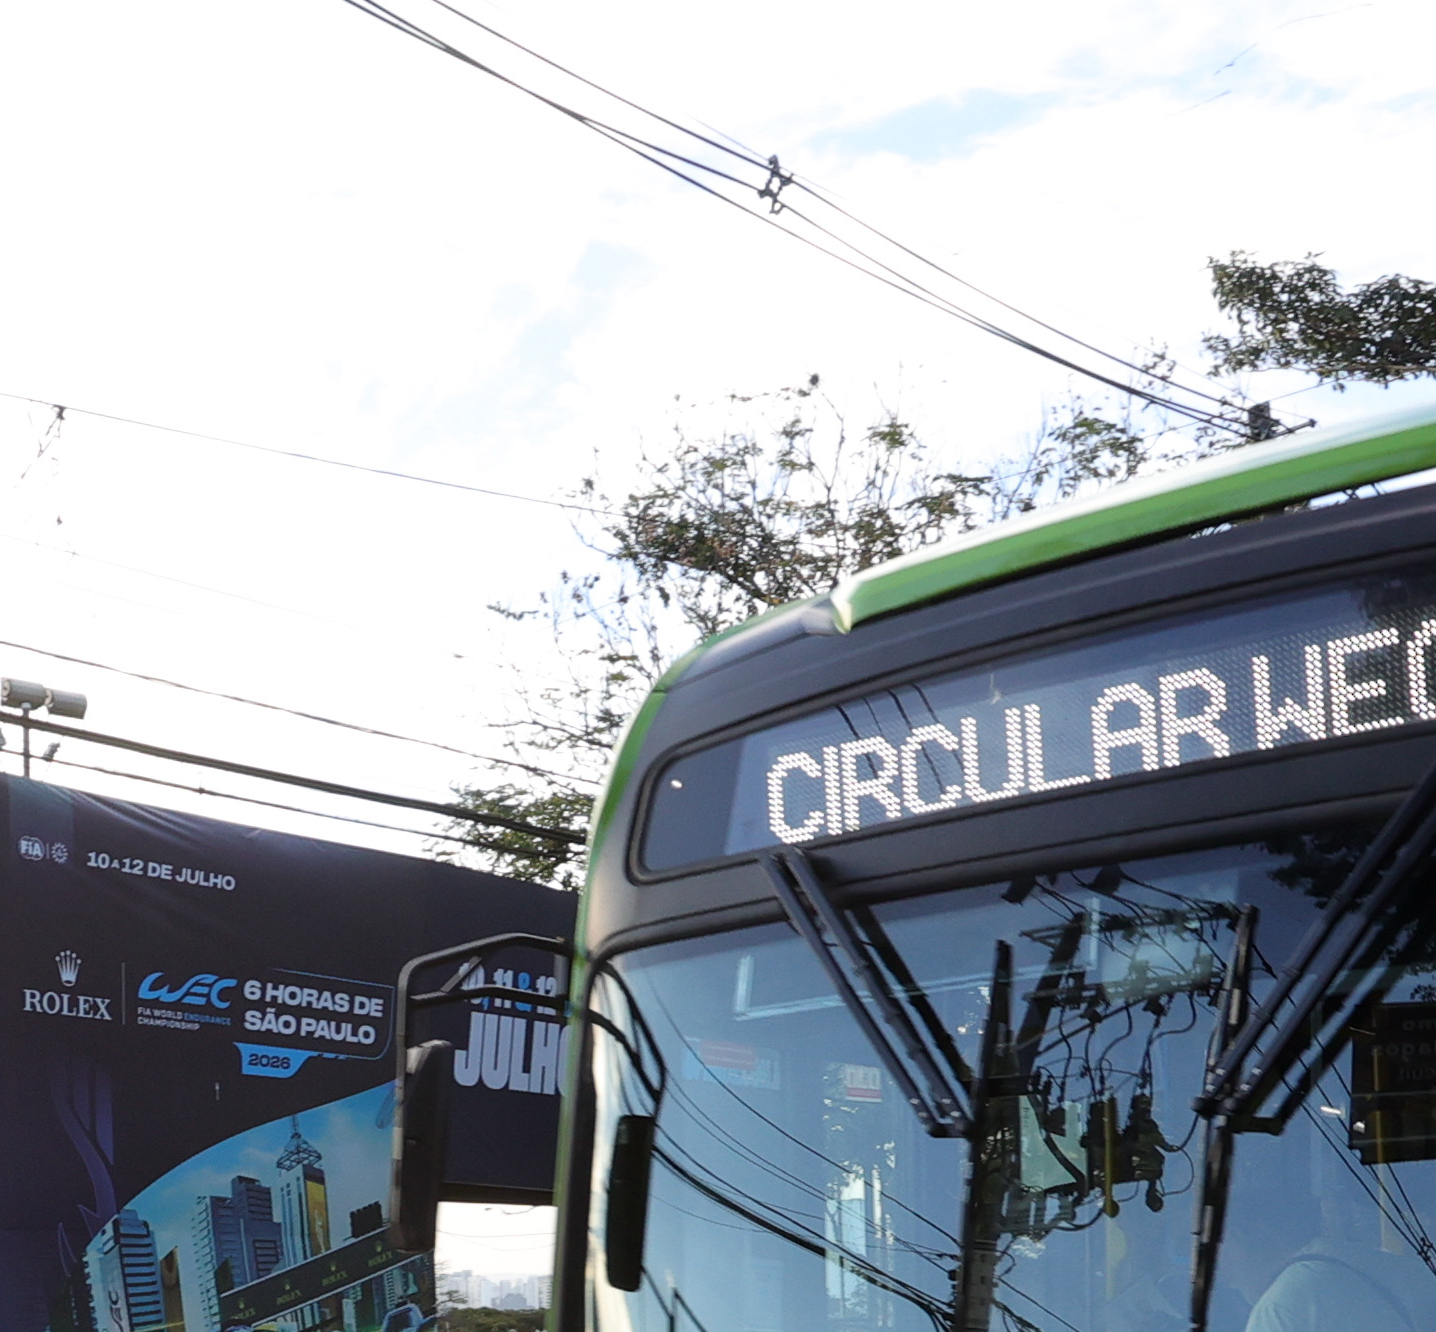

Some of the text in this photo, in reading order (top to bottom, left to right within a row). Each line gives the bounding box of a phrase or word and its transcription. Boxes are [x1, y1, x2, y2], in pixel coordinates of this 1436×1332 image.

[765, 667, 1231, 845] CIRCULAR
[19, 838, 44, 858] FIA
[87, 851, 236, 891] 10 A 12 DE JULHO
[23, 989, 113, 1021] ROLEX
[138, 972, 239, 1009] WEC
[243, 979, 384, 1018] 6 HORAS DE
[137, 1006, 152, 1016] FIA
[152, 1009, 183, 1020] WORLD
[137, 1016, 201, 1030] CHAMPIONSHIP
[244, 1007, 376, 1045] SÃO PAULO
[248, 1053, 291, 1069] 2026
